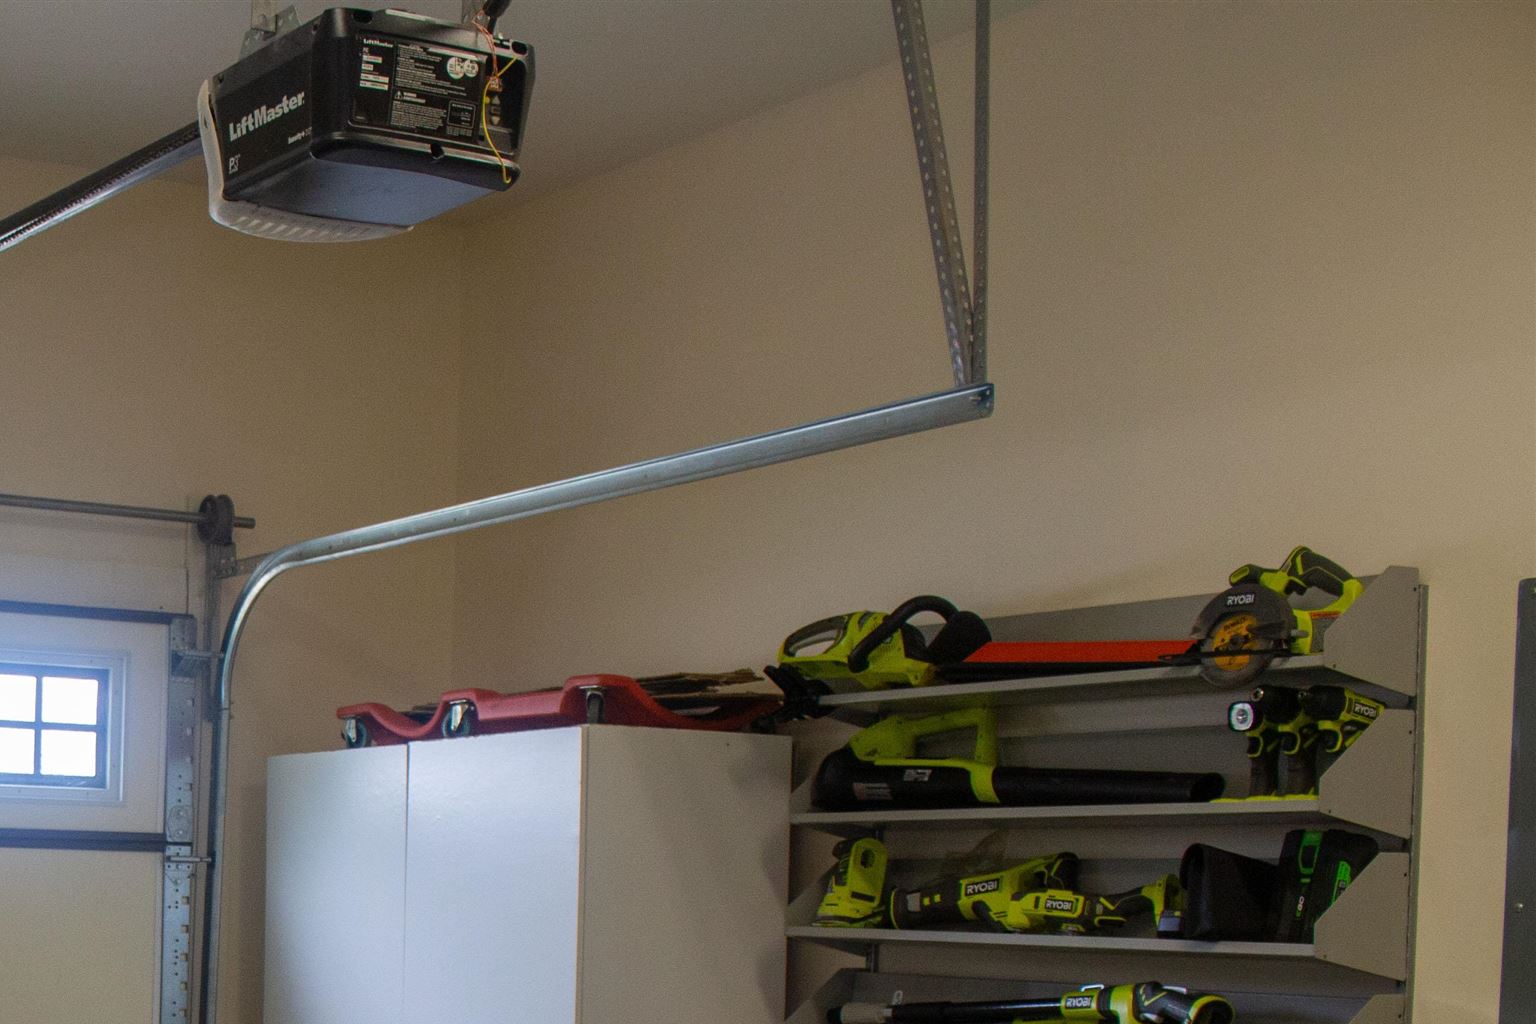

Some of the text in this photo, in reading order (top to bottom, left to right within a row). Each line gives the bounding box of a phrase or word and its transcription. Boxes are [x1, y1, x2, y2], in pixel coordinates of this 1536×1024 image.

[228, 91, 305, 142] LiftMaster
[1227, 594, 1255, 606] RYOBI
[966, 881, 997, 894] RYOBI
[1045, 900, 1072, 910] RYOBI
[1066, 996, 1092, 1009] RYOBI
